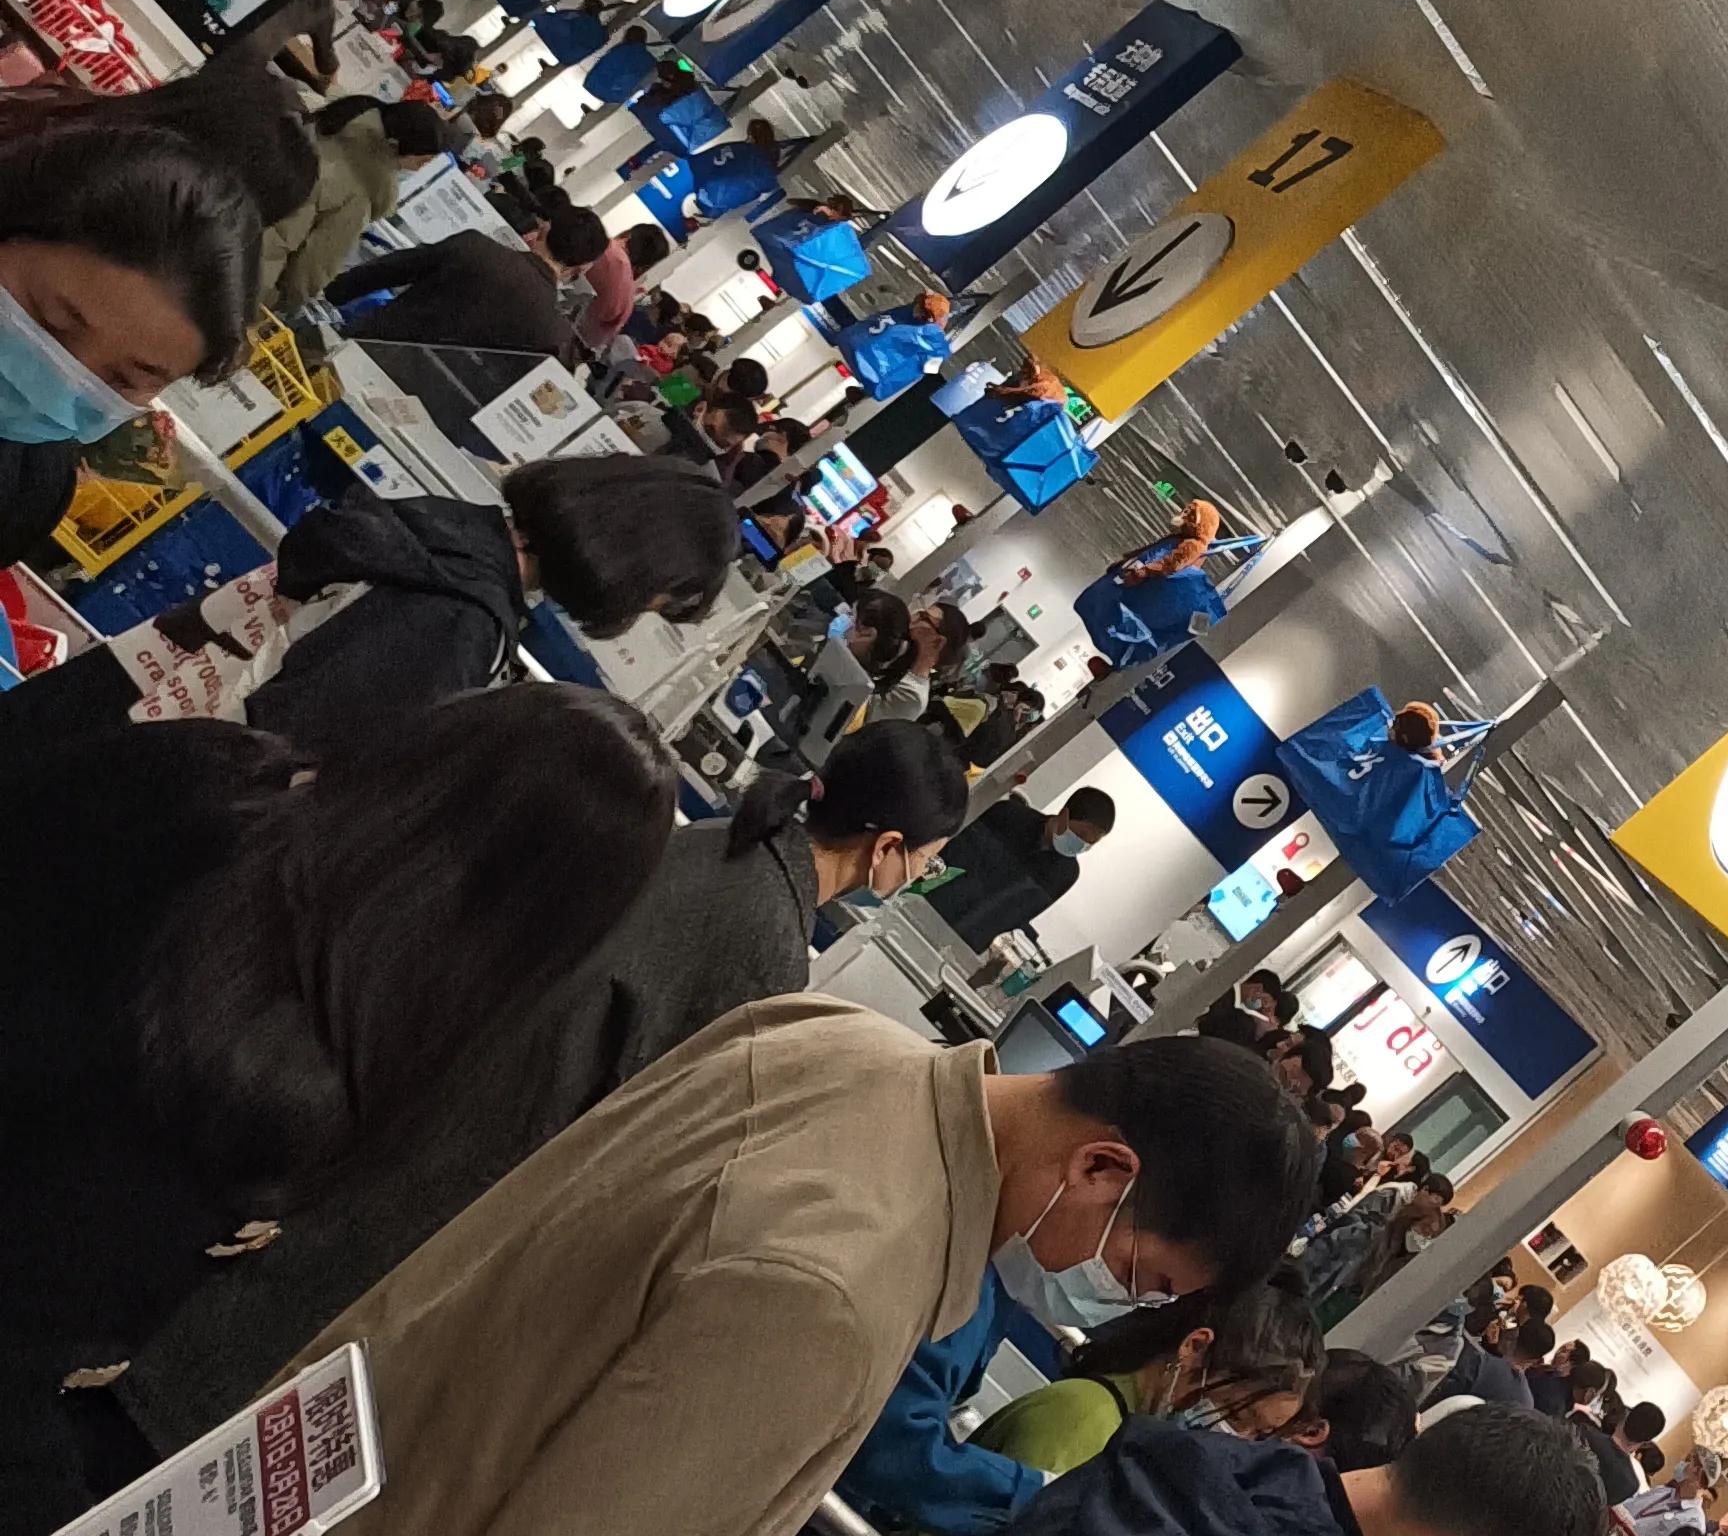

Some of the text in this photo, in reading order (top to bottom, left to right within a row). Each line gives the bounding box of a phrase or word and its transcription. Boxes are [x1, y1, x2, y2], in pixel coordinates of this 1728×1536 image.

[1247, 129, 1354, 194] 17
[1173, 721, 1194, 745] Exit
[1183, 702, 1230, 753] 出口
[305, 1376, 358, 1493] 限时特惠
